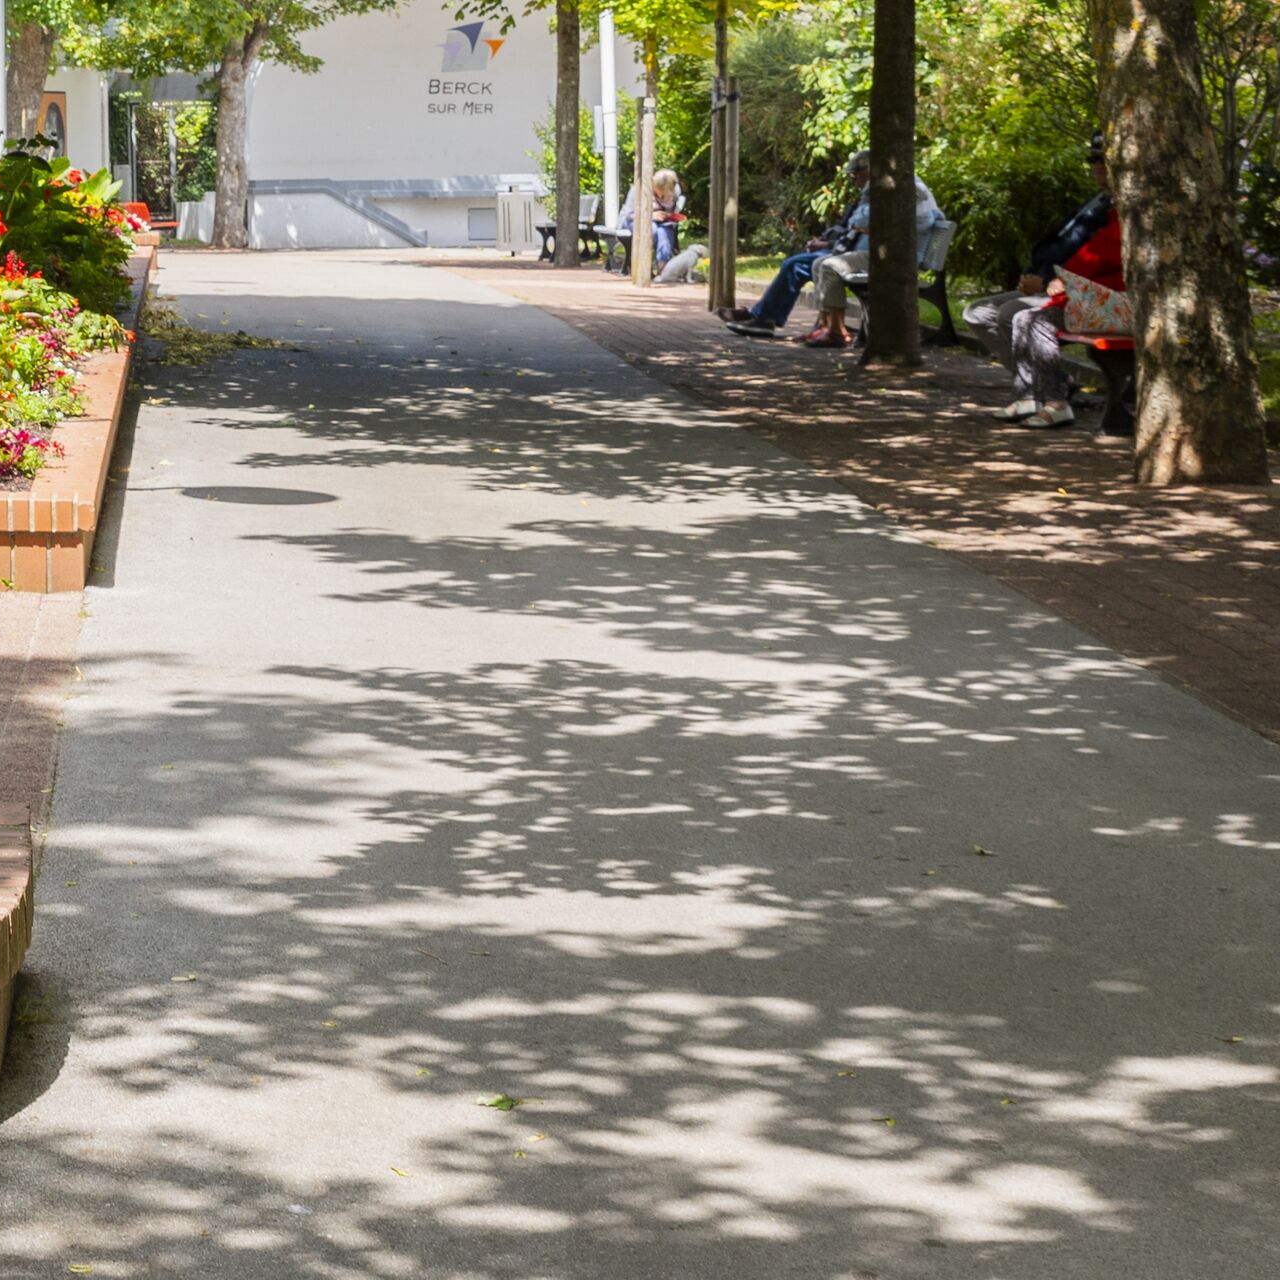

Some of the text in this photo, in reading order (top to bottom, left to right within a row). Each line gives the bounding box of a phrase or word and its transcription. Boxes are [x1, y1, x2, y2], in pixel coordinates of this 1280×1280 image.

[428, 79, 493, 95] BERCK
[427, 101, 494, 116] SUR MER
